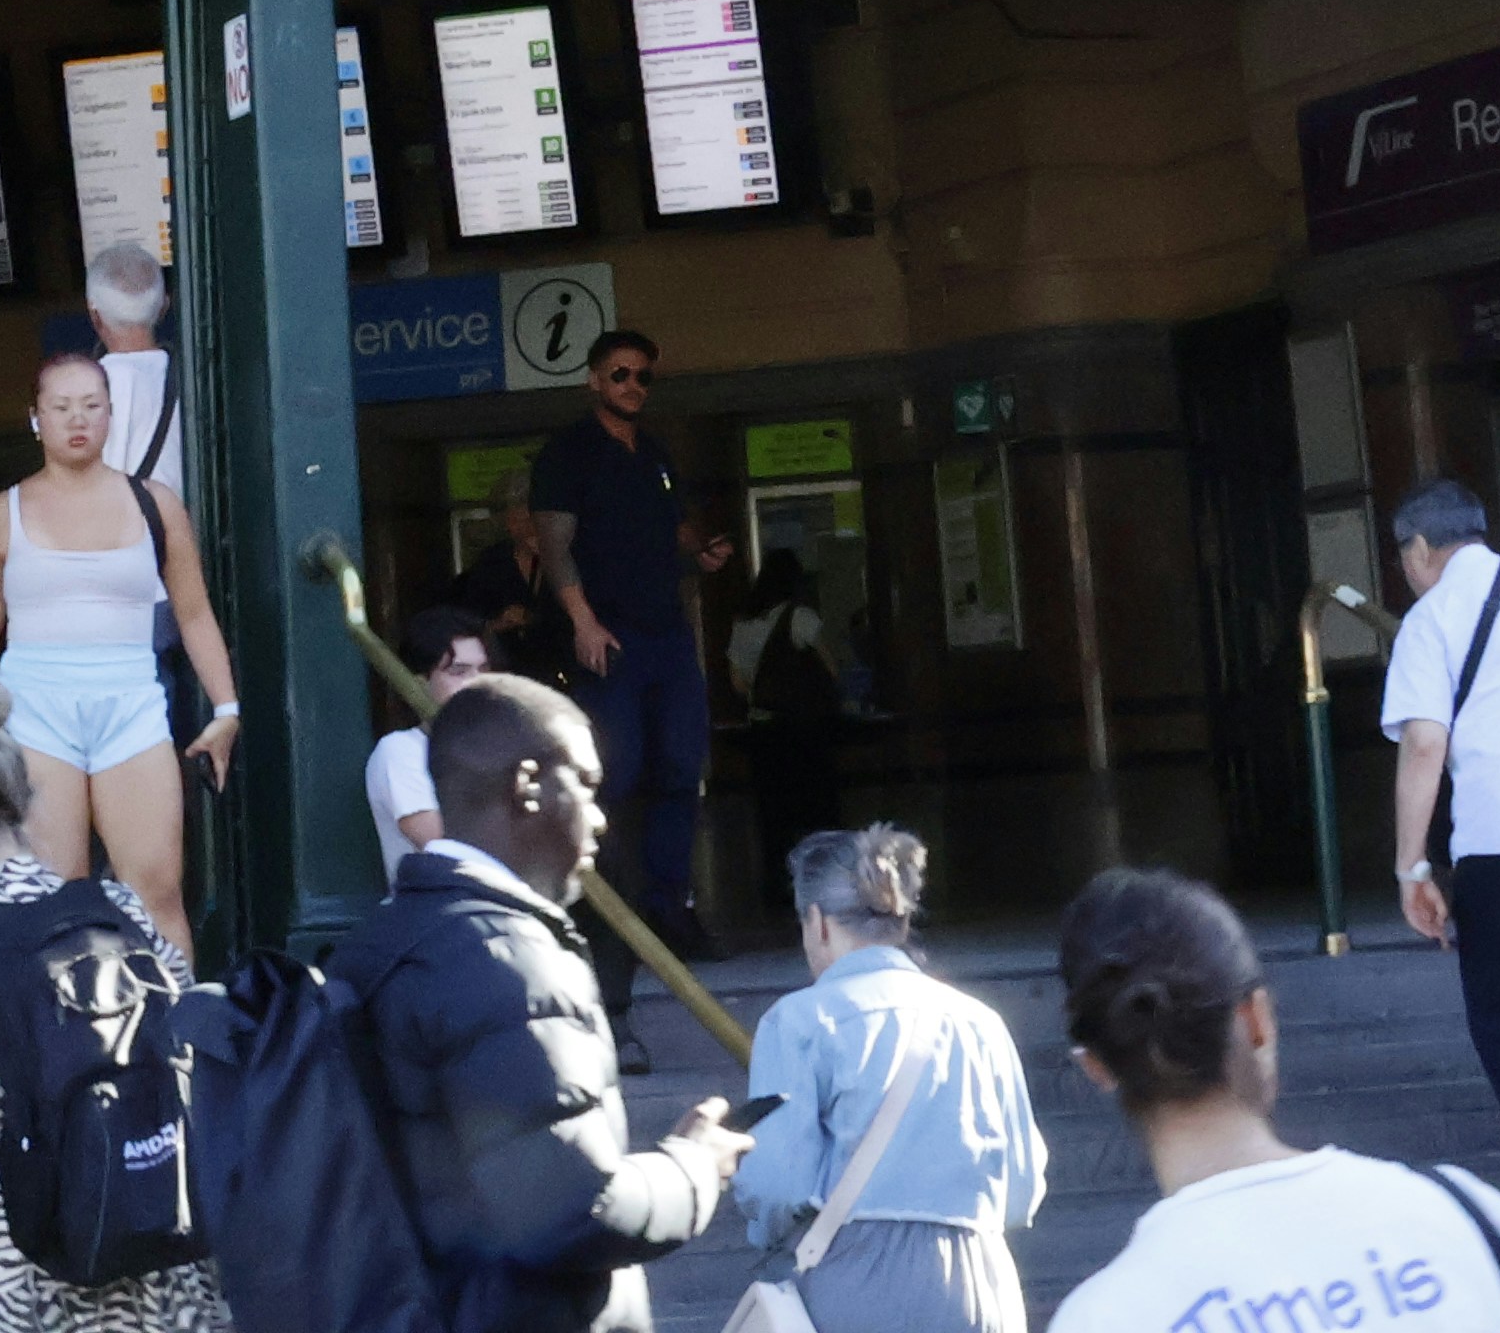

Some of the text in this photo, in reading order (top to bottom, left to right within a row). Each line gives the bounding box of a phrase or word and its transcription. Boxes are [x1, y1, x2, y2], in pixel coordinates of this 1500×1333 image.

[354, 305, 490, 356] ervice
[1168, 1248, 1444, 1333] Time is
